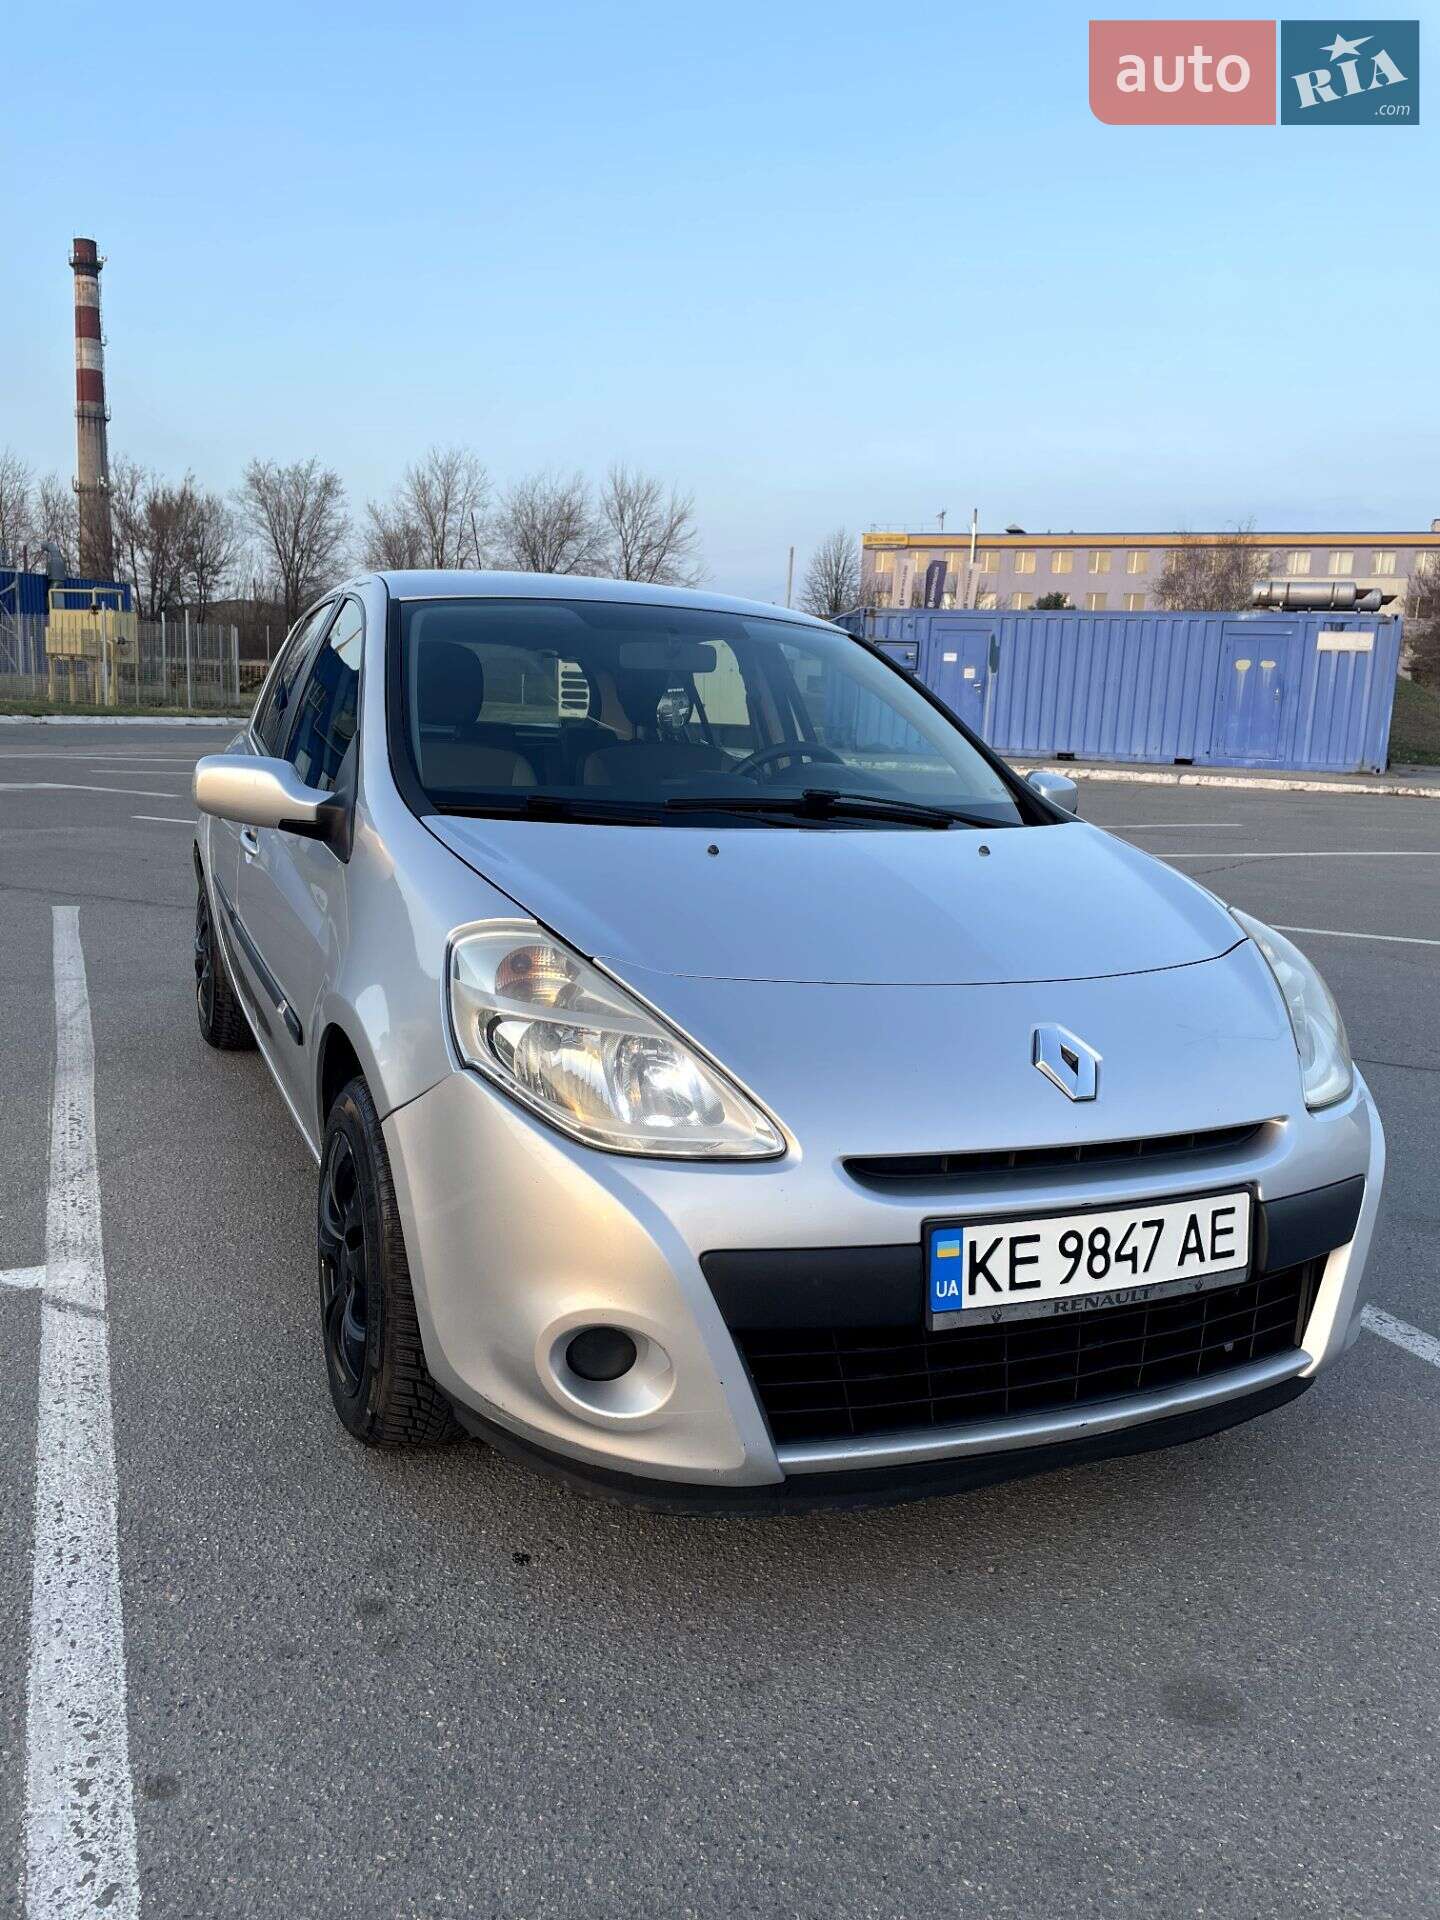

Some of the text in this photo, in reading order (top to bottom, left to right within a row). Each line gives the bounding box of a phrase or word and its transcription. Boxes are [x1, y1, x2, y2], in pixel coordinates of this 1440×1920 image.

[968, 1207, 1236, 1296] KE 9847 AE
[936, 1280, 959, 1298] UA
[1053, 1290, 1151, 1314] RENAULT
